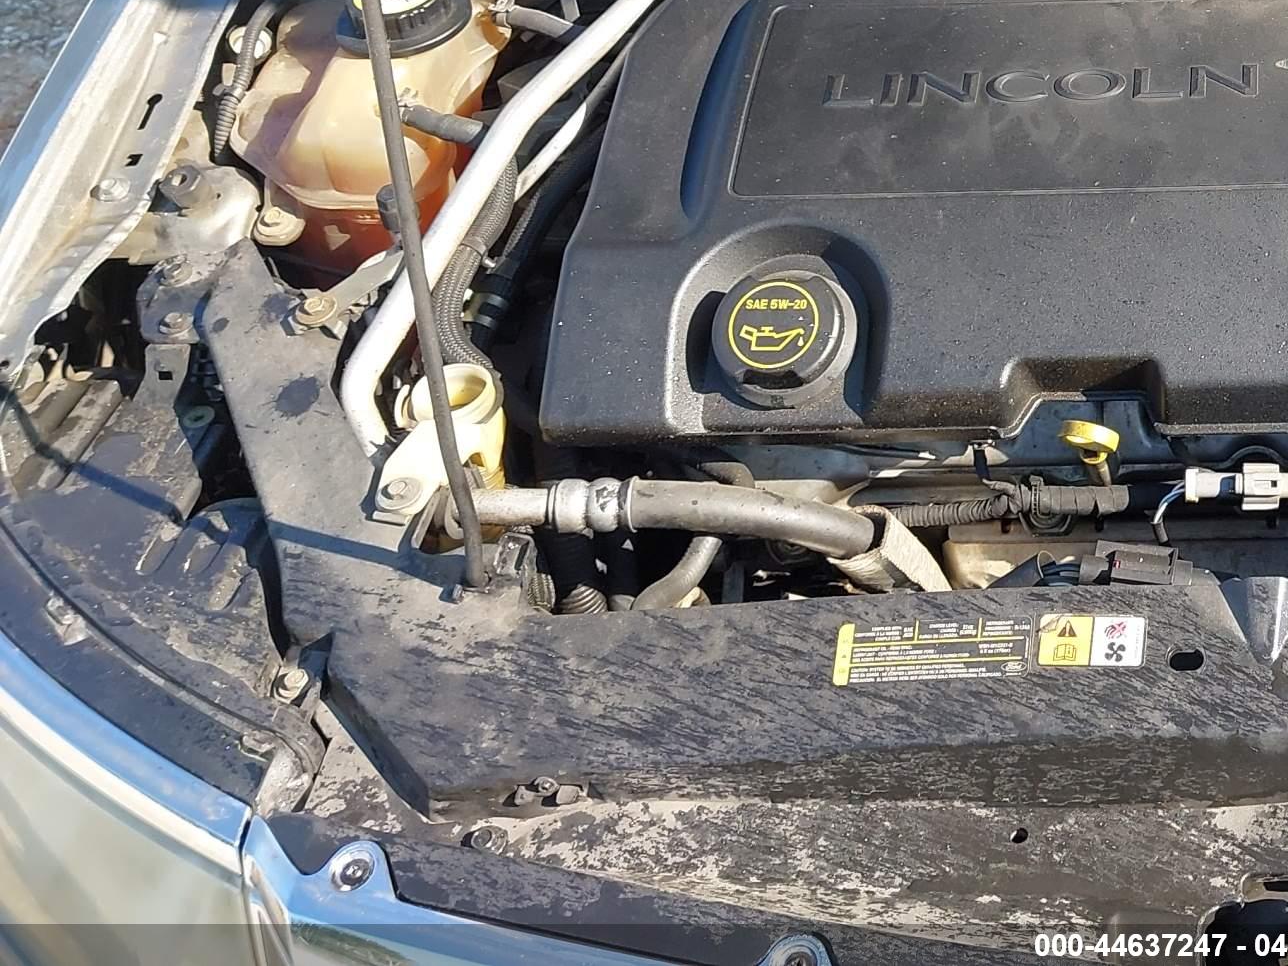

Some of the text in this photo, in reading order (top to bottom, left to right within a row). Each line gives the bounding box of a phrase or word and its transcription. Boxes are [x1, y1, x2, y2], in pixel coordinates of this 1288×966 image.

[821, 63, 1259, 107] LINCOLN
[745, 298, 808, 310] SAE 5W-20
